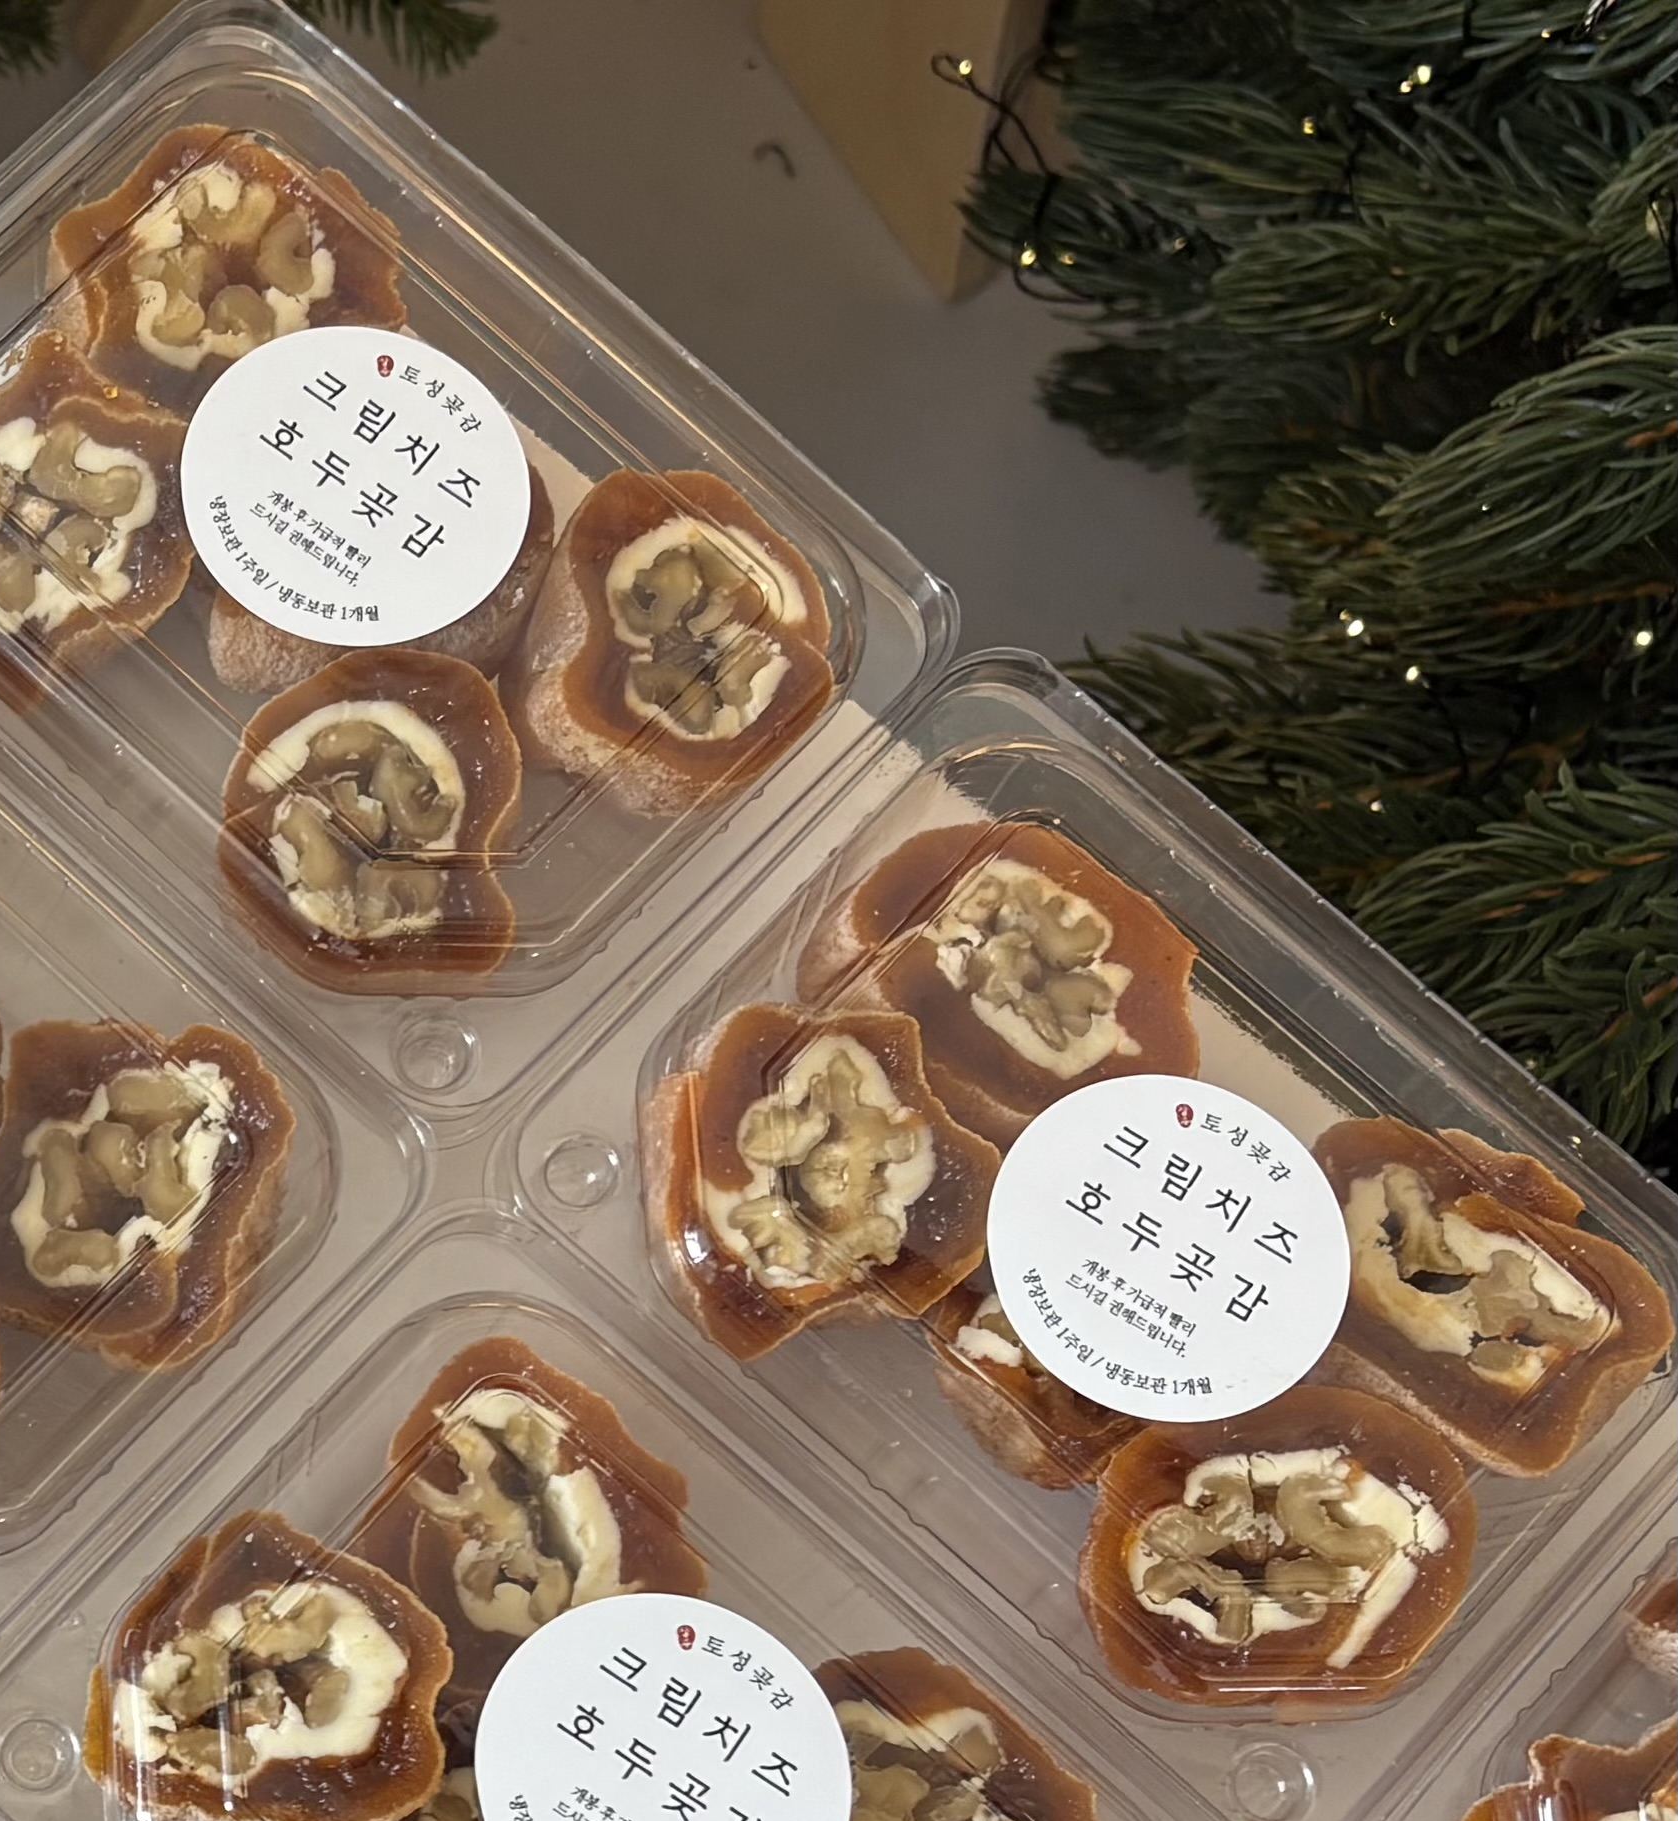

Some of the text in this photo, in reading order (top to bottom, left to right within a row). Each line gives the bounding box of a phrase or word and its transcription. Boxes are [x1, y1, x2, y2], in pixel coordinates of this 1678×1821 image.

[398, 365, 482, 433] 토성곶감
[302, 370, 481, 508] 크림치즈
[249, 502, 290, 535] 드시길
[259, 419, 445, 559] 호두곶감
[267, 490, 294, 513] 개봉
[293, 508, 309, 523] 후
[306, 518, 346, 551] 가급적
[209, 495, 243, 553] 냉장보관
[235, 551, 270, 586] 1주일
[278, 585, 336, 620] 냉동보관
[340, 605, 380, 622] 1개월
[1200, 1113, 1291, 1182] 토성곶감
[1103, 1126, 1299, 1264] 크림치즈
[1065, 1181, 1269, 1322] 호두곶감
[1081, 1259, 1111, 1282] 개봉
[1110, 1276, 1127, 1291] 후
[1125, 1286, 1169, 1319] 가급적
[1065, 1273, 1109, 1306] 드시길
[1022, 1268, 1063, 1329] 냉장보관
[1056, 1327, 1095, 1364] 1주일
[1105, 1361, 1167, 1395] 냉동보관
[1172, 1376, 1213, 1396] 1개월
[701, 1635, 794, 1710] 토성곶감
[599, 1646, 798, 1797] 크림치즈
[571, 1786, 600, 1811] 개봉
[599, 1805, 617, 1821] 후
